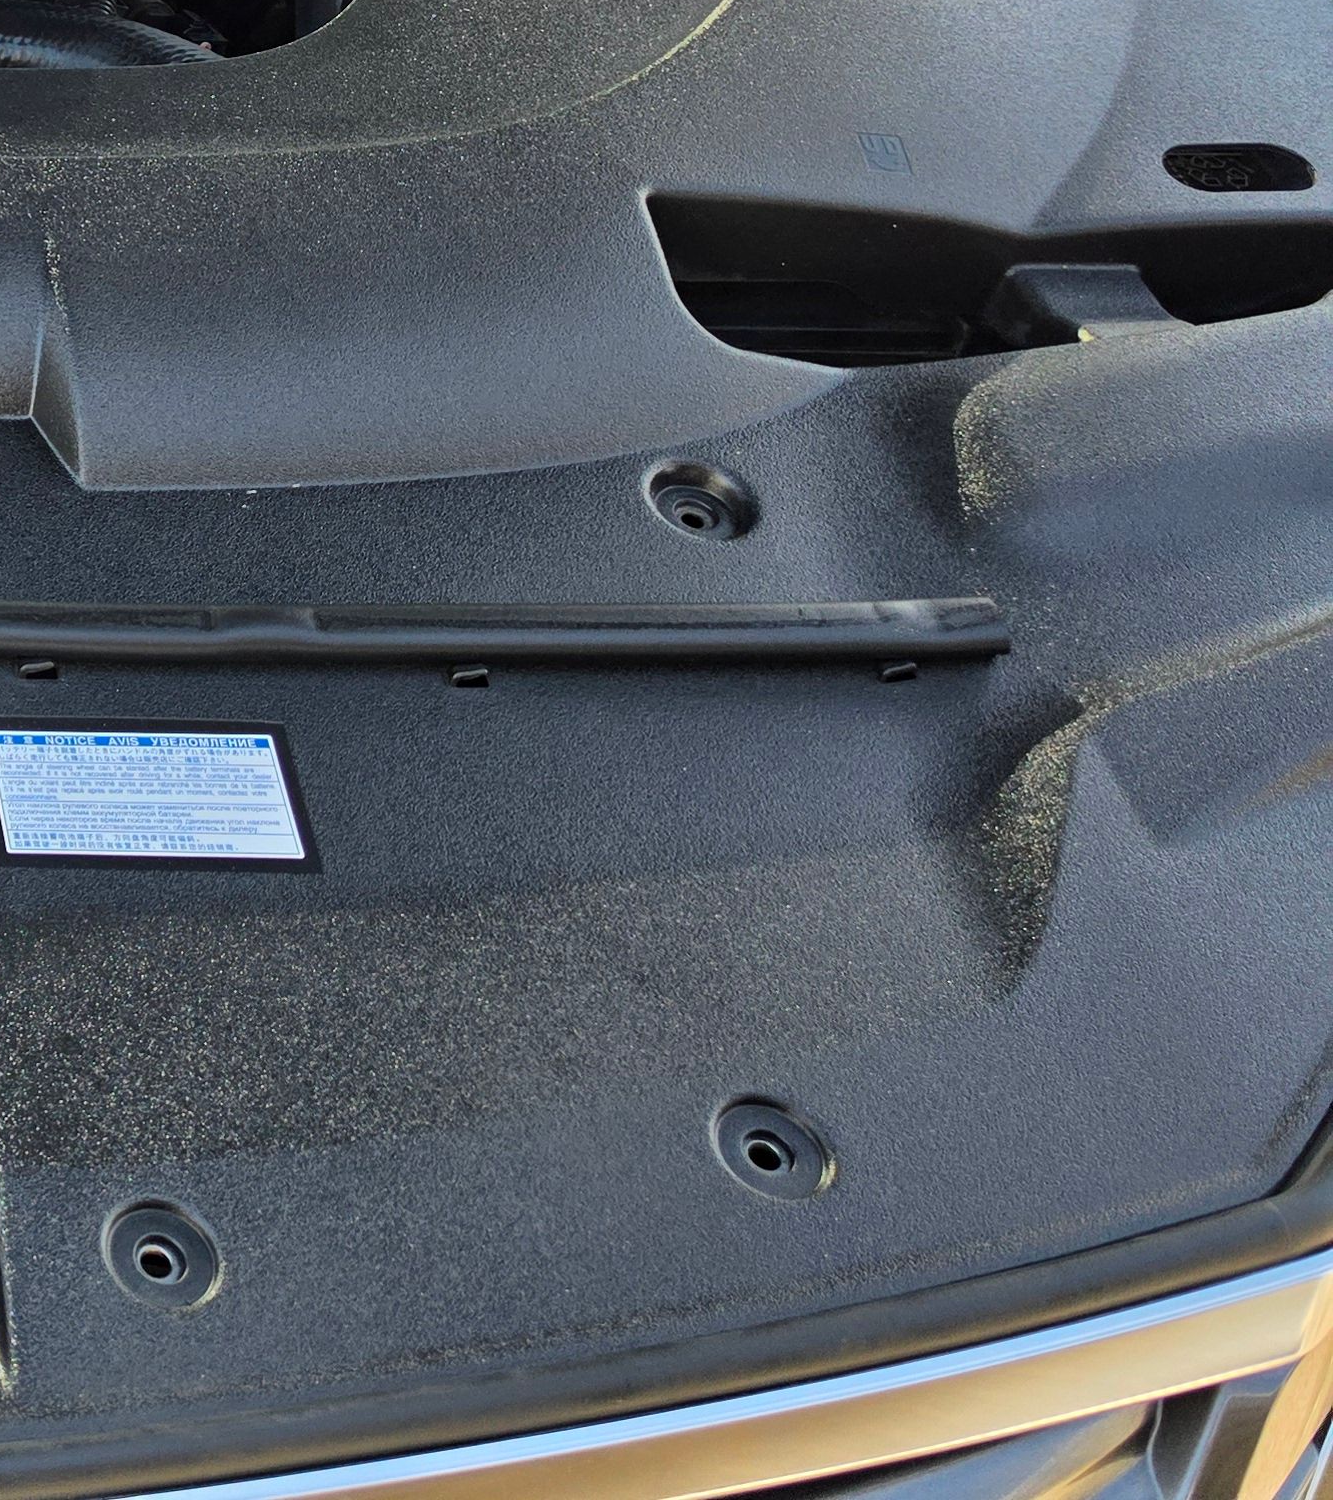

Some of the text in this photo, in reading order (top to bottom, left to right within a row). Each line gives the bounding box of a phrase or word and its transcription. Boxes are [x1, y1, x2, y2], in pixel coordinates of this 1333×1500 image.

[45, 736, 96, 746] NOTICE
[108, 737, 139, 746] AVIS
[149, 737, 257, 748] УВЕДОМЛЕНИЕ
